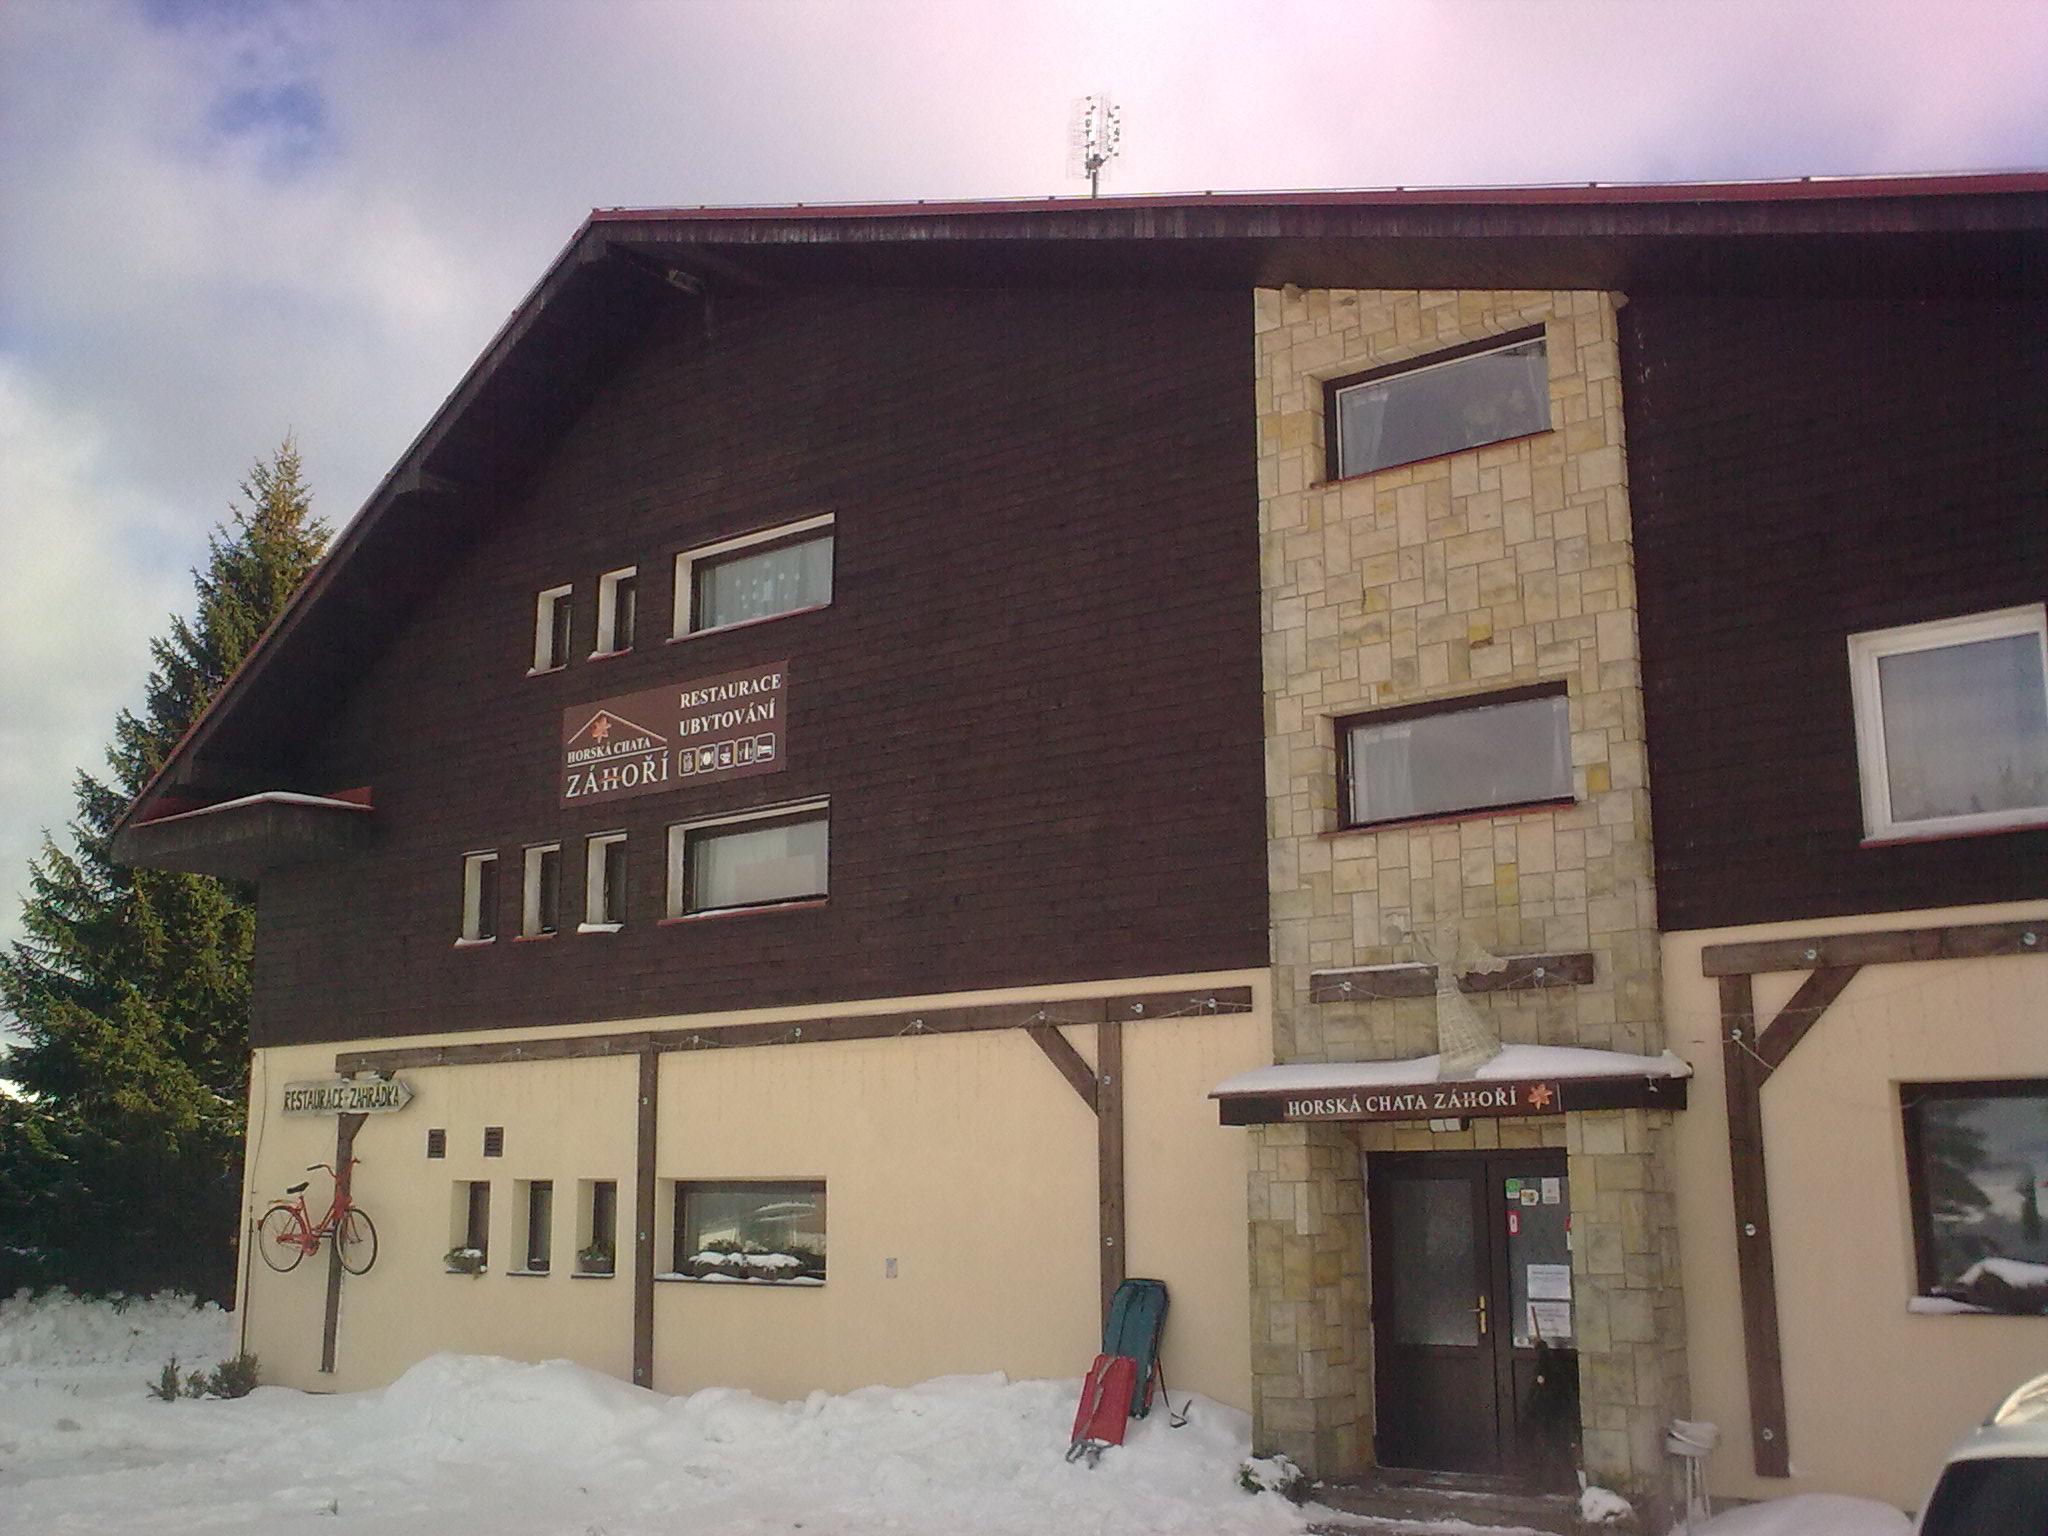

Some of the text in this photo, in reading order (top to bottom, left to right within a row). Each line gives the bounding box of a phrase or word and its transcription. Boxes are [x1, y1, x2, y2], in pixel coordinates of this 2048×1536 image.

[680, 673, 782, 709] RESTAURACE
[679, 698, 776, 737] UBYTOVÁNÍ
[567, 736, 651, 764] HORSKÁ CHATA
[565, 750, 670, 798] ZÁHOŘÍ
[1288, 1085, 1517, 1117] HORSKÁ CHATA ZÁHOŘÍ
